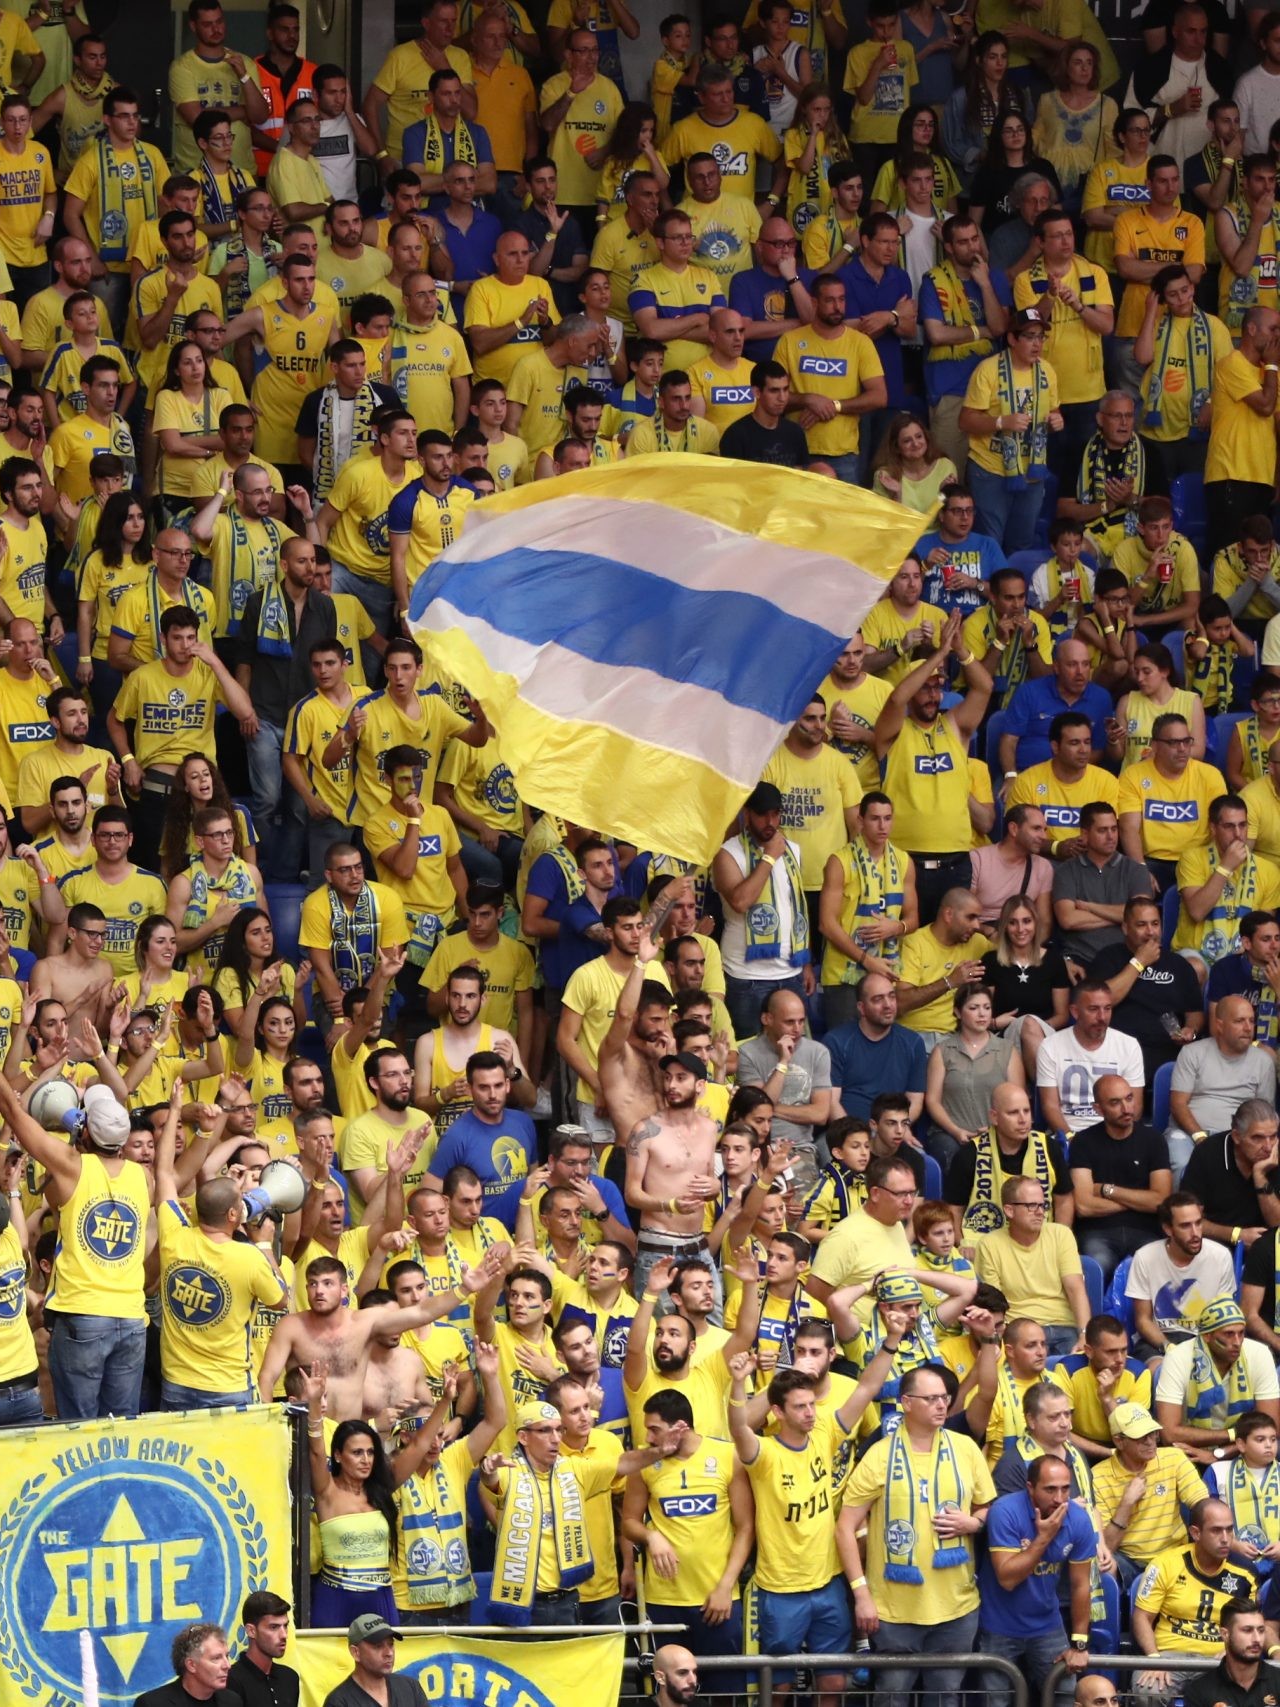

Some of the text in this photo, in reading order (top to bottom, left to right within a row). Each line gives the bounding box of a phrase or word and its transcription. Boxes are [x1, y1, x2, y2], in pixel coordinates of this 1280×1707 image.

[1111, 186, 1151, 199] FOX
[1149, 249, 1177, 261] Trade
[296, 332, 305, 350] 6
[803, 360, 842, 374] FOX
[715, 389, 751, 401] FOX
[14, 726, 51, 740] FOX
[142, 720, 178, 730] SINCE
[780, 793, 814, 805] SRAEL
[1149, 803, 1193, 820] FOX
[93, 1214, 134, 1241] GATE
[174, 1281, 216, 1312] GATE
[52, 1436, 194, 1478] YELLOW ARMY
[812, 1455, 826, 1483] 12
[679, 1470, 687, 1490] 1
[664, 1497, 714, 1516] FOX
[39, 1530, 69, 1547] THE
[562, 1525, 573, 1563] PASSION
[573, 1524, 583, 1558] YELLOW
[41, 1538, 204, 1632] GATE
[501, 1585, 510, 1599] WE
[513, 1586, 523, 1602] ARE
